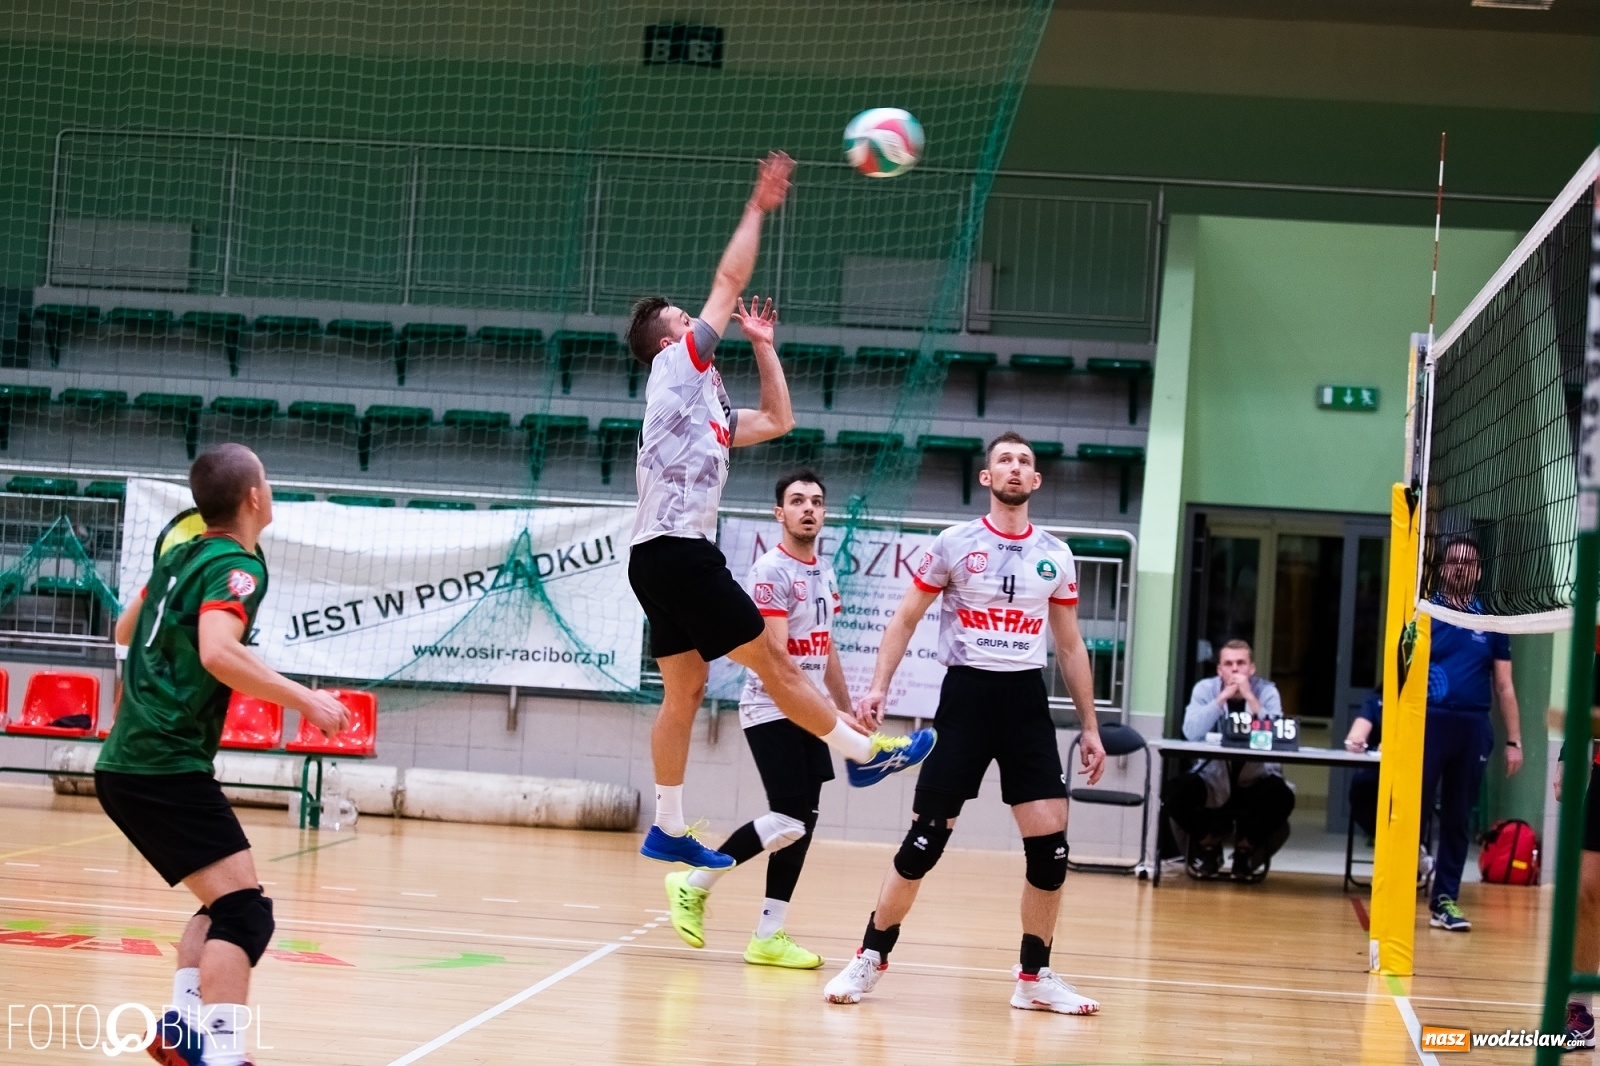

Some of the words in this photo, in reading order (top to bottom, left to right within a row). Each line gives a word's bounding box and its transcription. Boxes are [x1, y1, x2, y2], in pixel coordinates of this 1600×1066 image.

[1002, 574, 1016, 603] 4
[285, 600, 363, 641] JEST
[374, 591, 404, 619] W
[412, 642, 616, 667] www.osir-raciborz.pl
[976, 637, 1009, 649] GRUPA
[1012, 639, 1030, 650] PBG
[1274, 718, 1297, 740] 15
